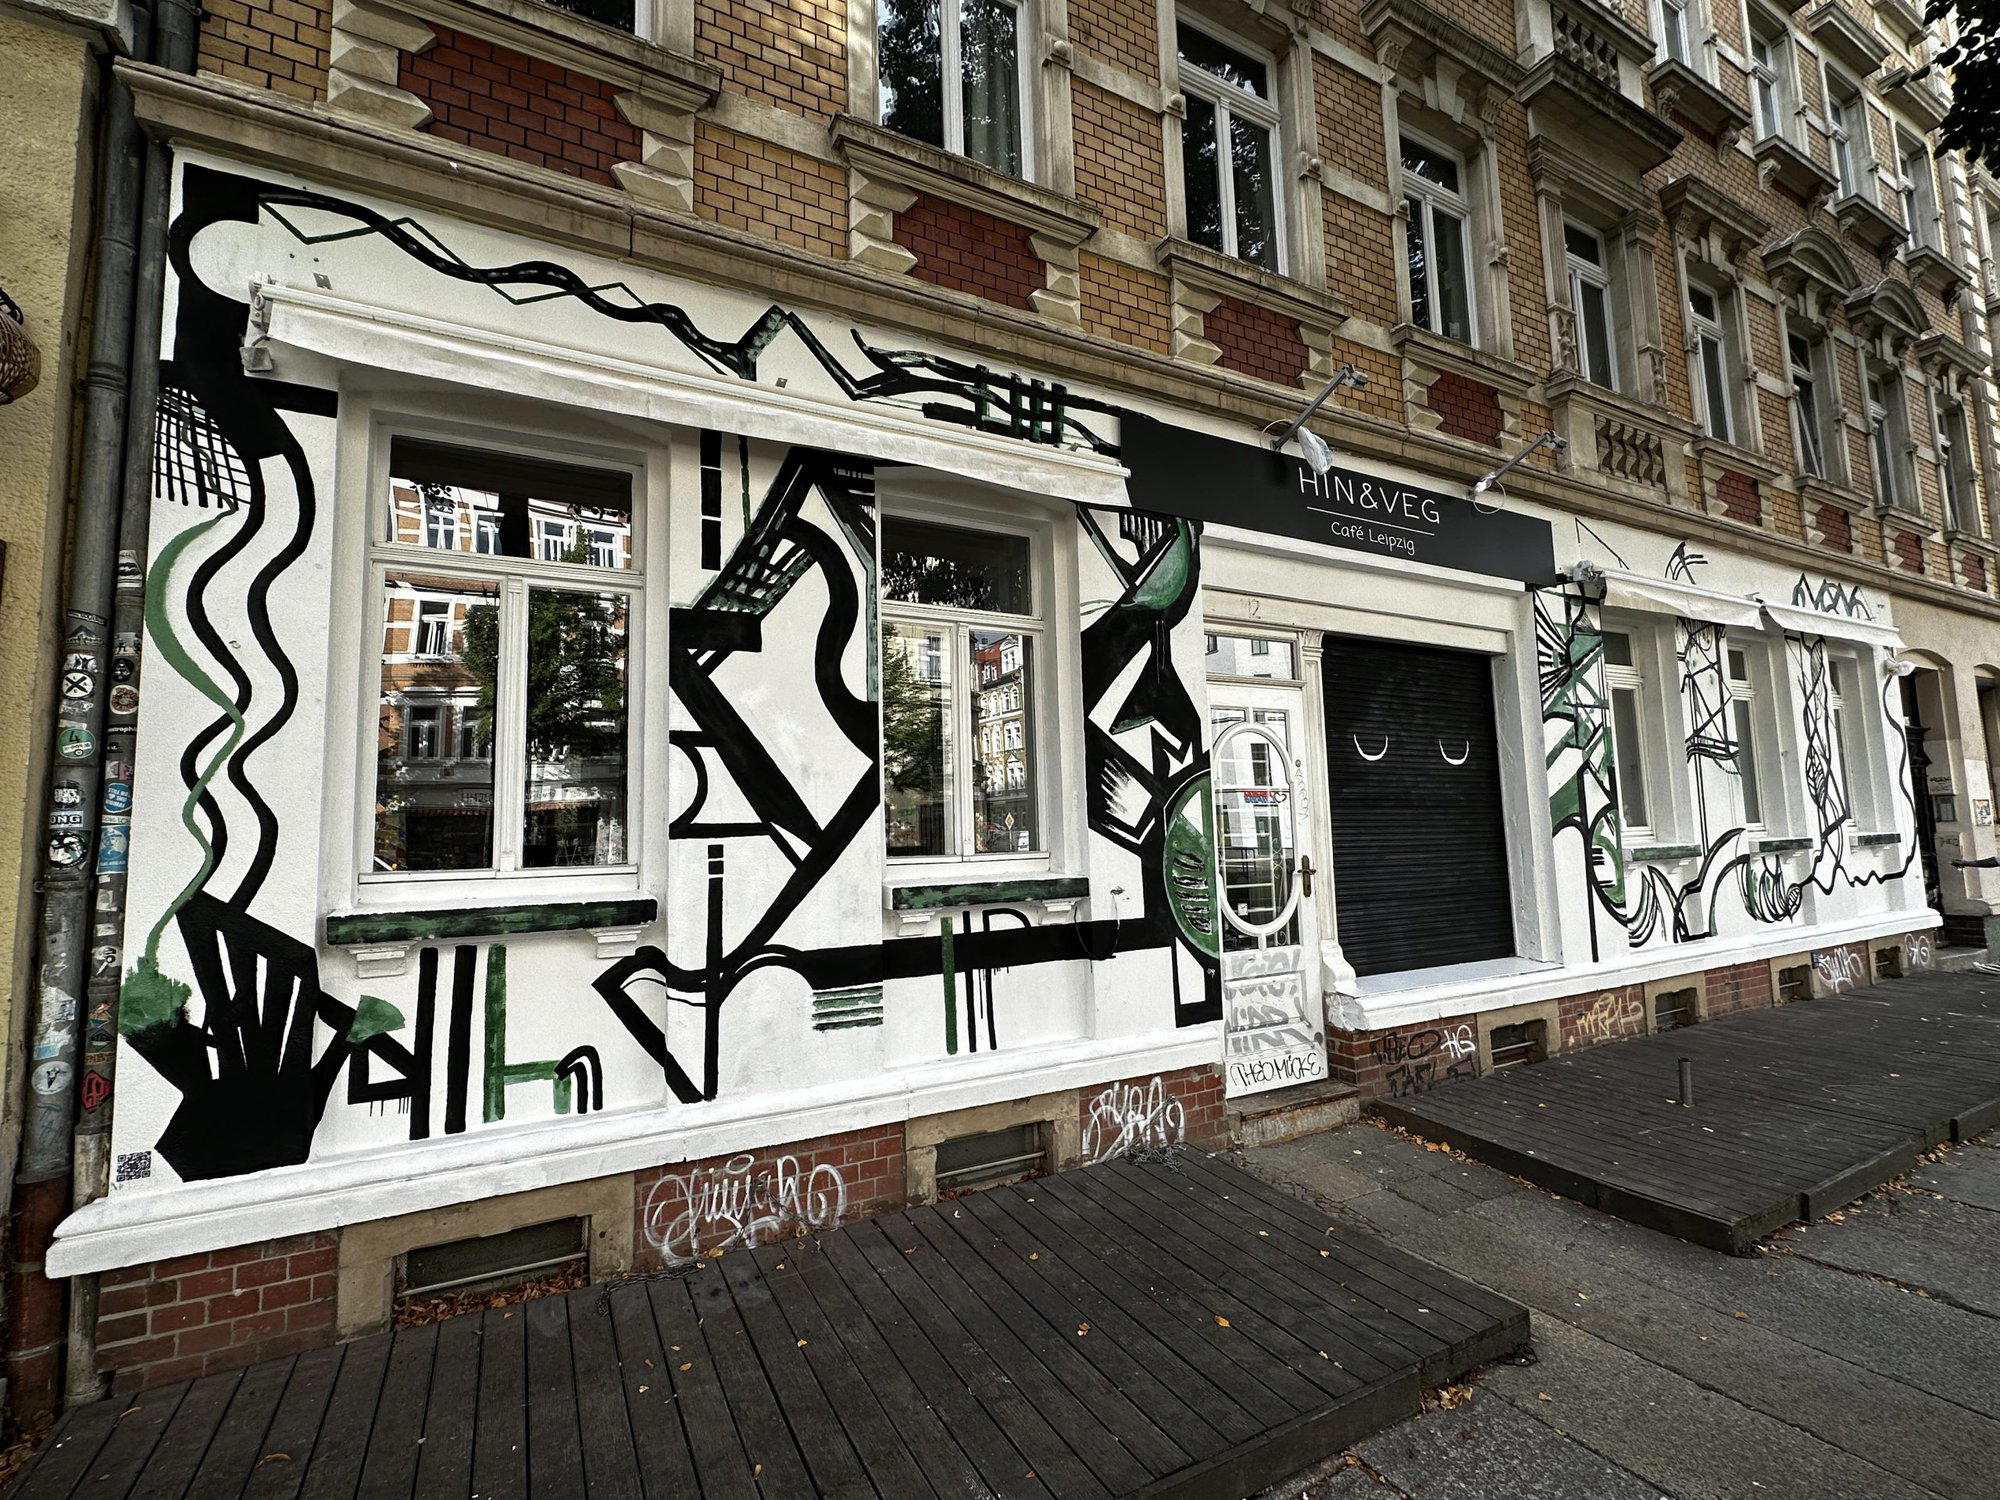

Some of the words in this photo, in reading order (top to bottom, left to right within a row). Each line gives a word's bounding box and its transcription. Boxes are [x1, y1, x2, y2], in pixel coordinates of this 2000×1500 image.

[1298, 466, 1440, 524] HIN&VEG
[1331, 521, 1364, 540] Café
[1368, 528, 1415, 556] Leipzig
